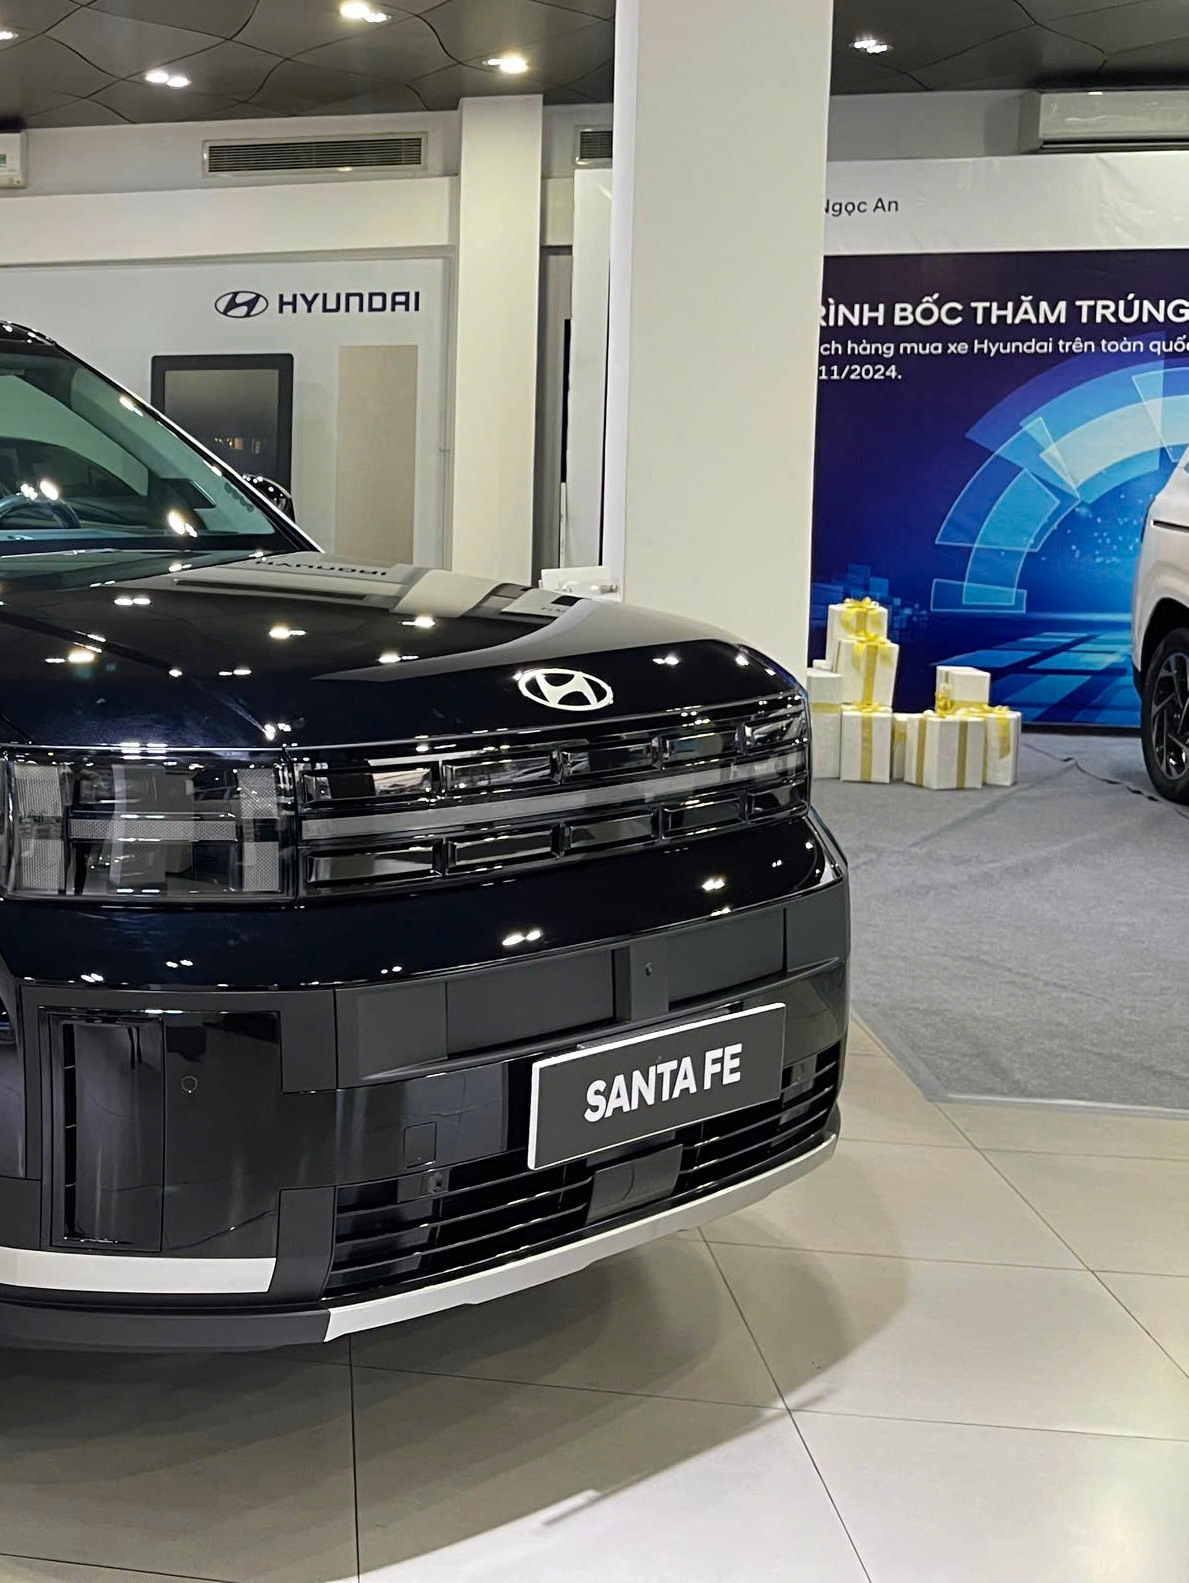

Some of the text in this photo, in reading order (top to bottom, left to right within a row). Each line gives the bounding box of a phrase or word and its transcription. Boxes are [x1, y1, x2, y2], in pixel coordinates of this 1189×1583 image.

[873, 197, 898, 212] An
[278, 291, 420, 314] HYUNDAI
[894, 292, 963, 326] BỐC
[970, 295, 1067, 325] THĂM
[1075, 293, 1189, 323] TRÚNG
[847, 339, 894, 358] hàng
[899, 342, 942, 355] mua
[947, 342, 969, 354] xe
[974, 338, 1053, 357] Hyundai
[1058, 337, 1095, 353] trên
[1101, 337, 1144, 353] toàn
[1149, 335, 1189, 355] quố
[584, 1043, 742, 1122] SANTA FE
